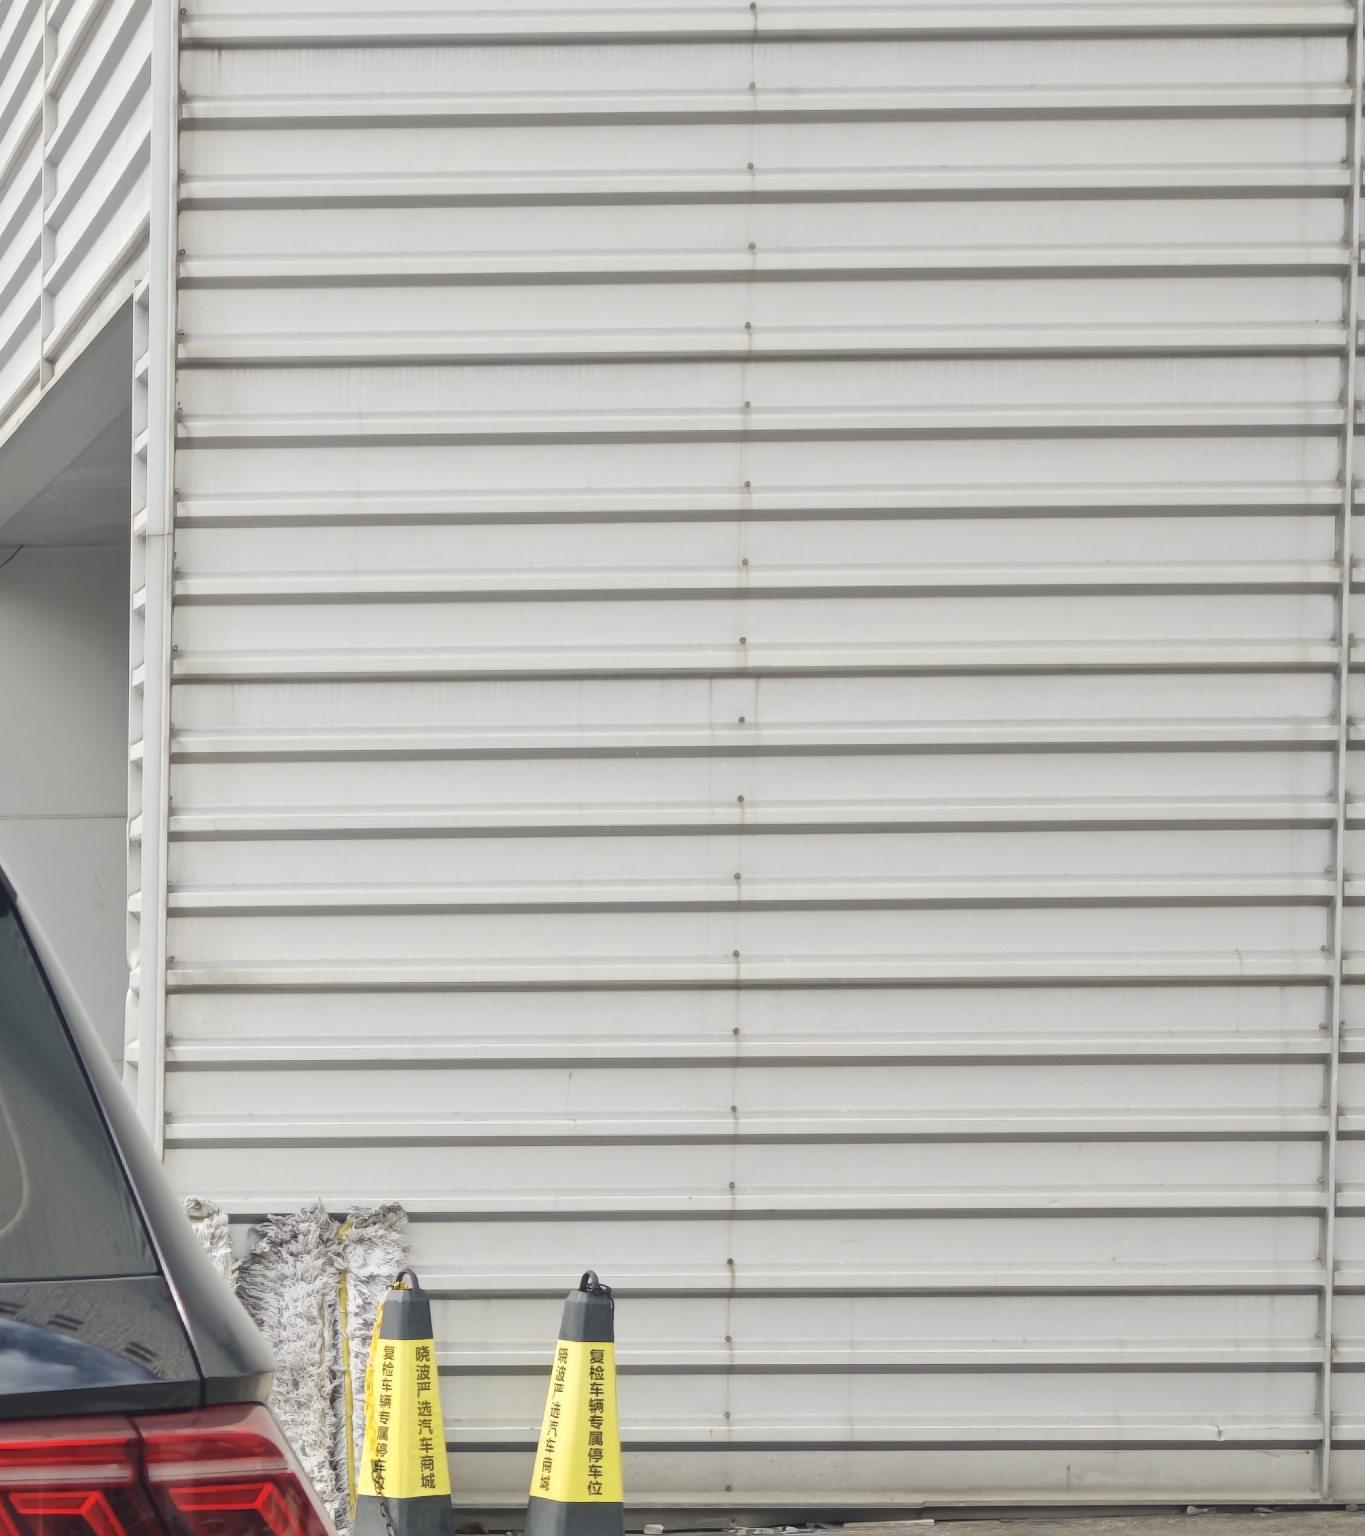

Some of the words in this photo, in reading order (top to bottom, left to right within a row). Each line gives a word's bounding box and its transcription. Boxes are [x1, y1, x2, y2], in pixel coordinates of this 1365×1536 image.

[415, 1345, 436, 1489] 晓波严选汽车商城
[586, 1348, 605, 1496] 复检车辆专属停车位
